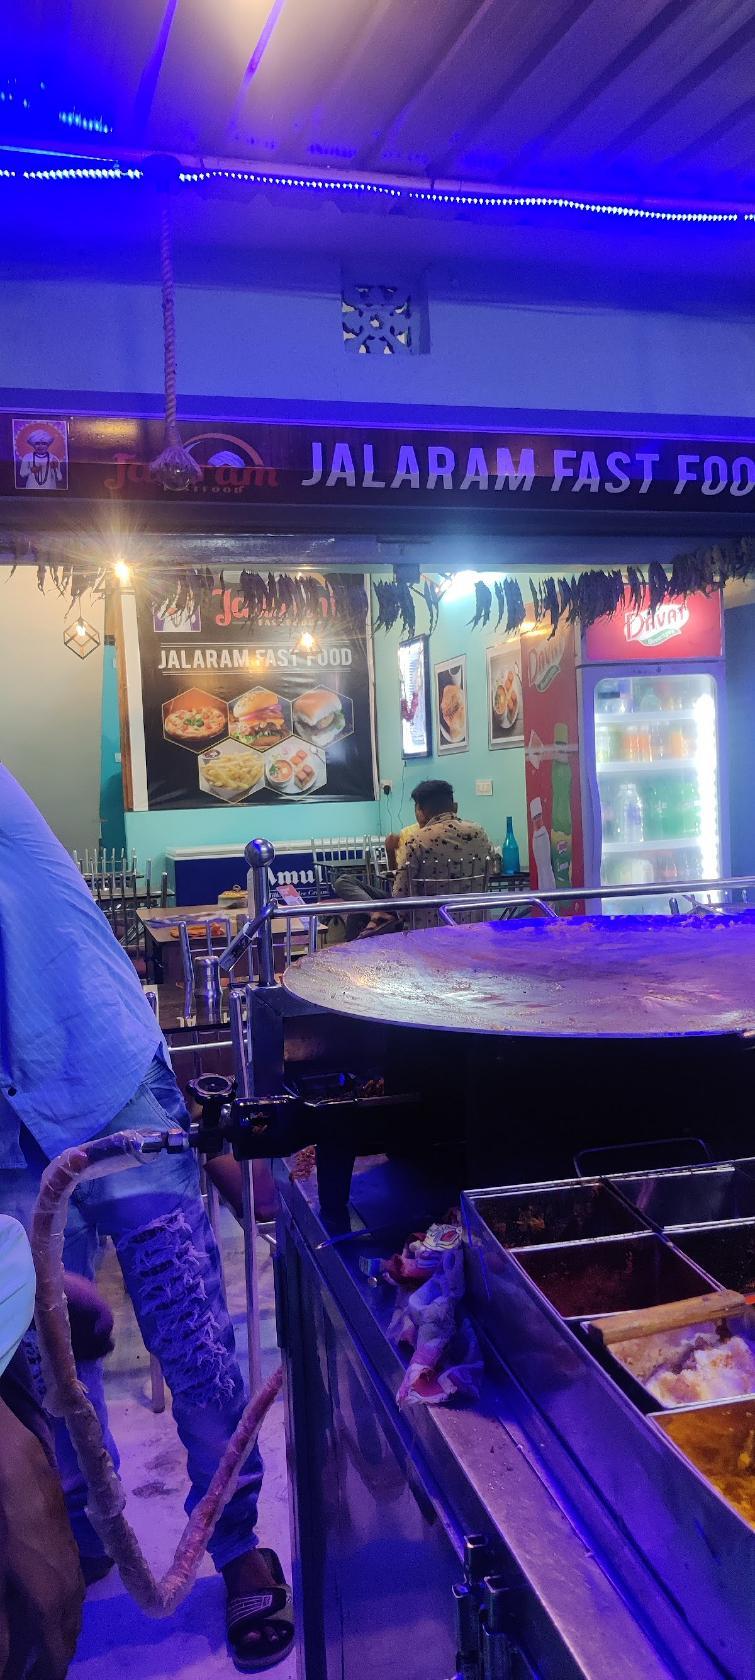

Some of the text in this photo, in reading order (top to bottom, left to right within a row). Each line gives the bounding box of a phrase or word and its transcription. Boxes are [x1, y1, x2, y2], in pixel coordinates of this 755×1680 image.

[301, 441, 536, 492] JALARAM
[550, 450, 660, 494] FAST
[158, 648, 248, 669] JALARAM
[255, 648, 299, 668] FAST
